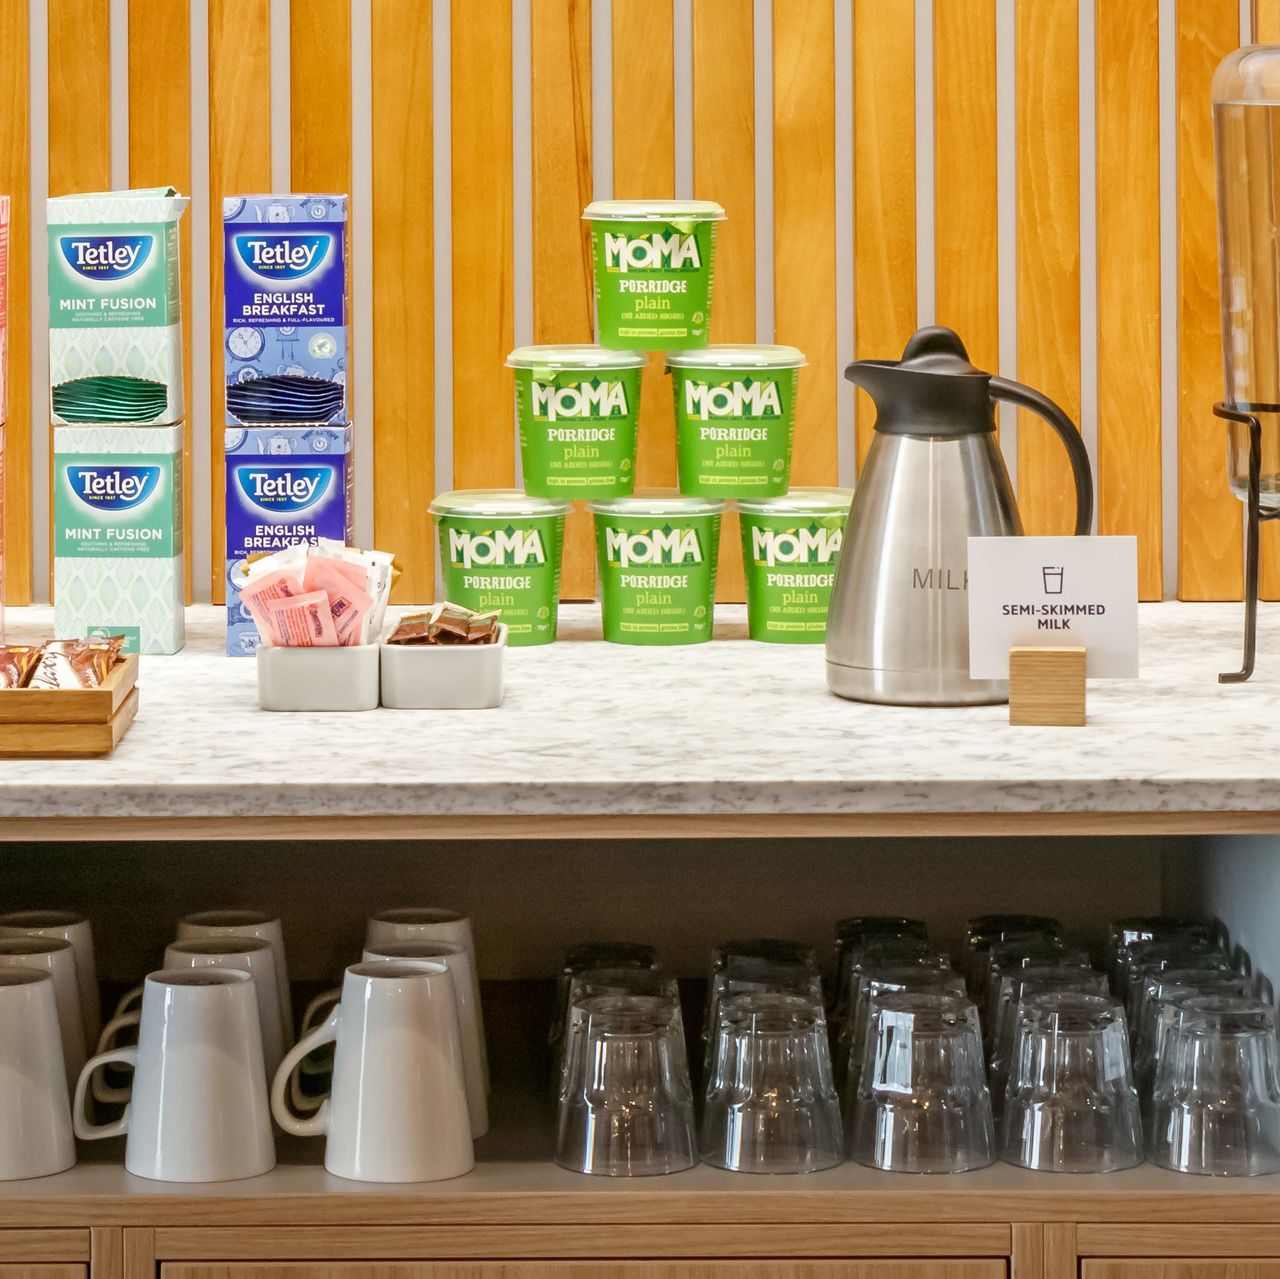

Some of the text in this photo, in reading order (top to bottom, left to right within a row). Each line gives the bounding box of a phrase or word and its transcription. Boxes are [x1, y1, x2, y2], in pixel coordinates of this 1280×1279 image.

[71, 240, 142, 271] Tetley
[247, 240, 319, 271] Tetley
[604, 232, 701, 273] MOMA
[618, 279, 687, 294] PORRIDGE
[59, 297, 157, 310] MINT FUSION
[253, 293, 314, 304] ENGLISH
[635, 295, 672, 311] plain
[242, 304, 325, 316] BREAKFAST
[531, 381, 628, 422] MOMA
[685, 379, 782, 421] MOMA
[546, 428, 616, 441] PORRIDGE
[699, 427, 769, 441] PORRIDGE
[564, 444, 600, 460] plain
[715, 443, 752, 459] plain
[78, 471, 149, 501] Tetley
[248, 472, 320, 503] Tetley
[65, 528, 163, 540] MINT FUSION
[255, 525, 315, 536] ENGLISH
[244, 536, 319, 548] BREAKFAS
[449, 527, 546, 569] MOMA
[605, 527, 703, 568] MOMA
[463, 575, 532, 590] PORRIDGE
[620, 574, 689, 589] PORRIDGE
[479, 592, 515, 608] plain
[636, 591, 672, 607] plain
[782, 589, 819, 606] plain
[1001, 604, 1106, 617] SEMI-SKIMMED
[1037, 618, 1071, 631] MILK
